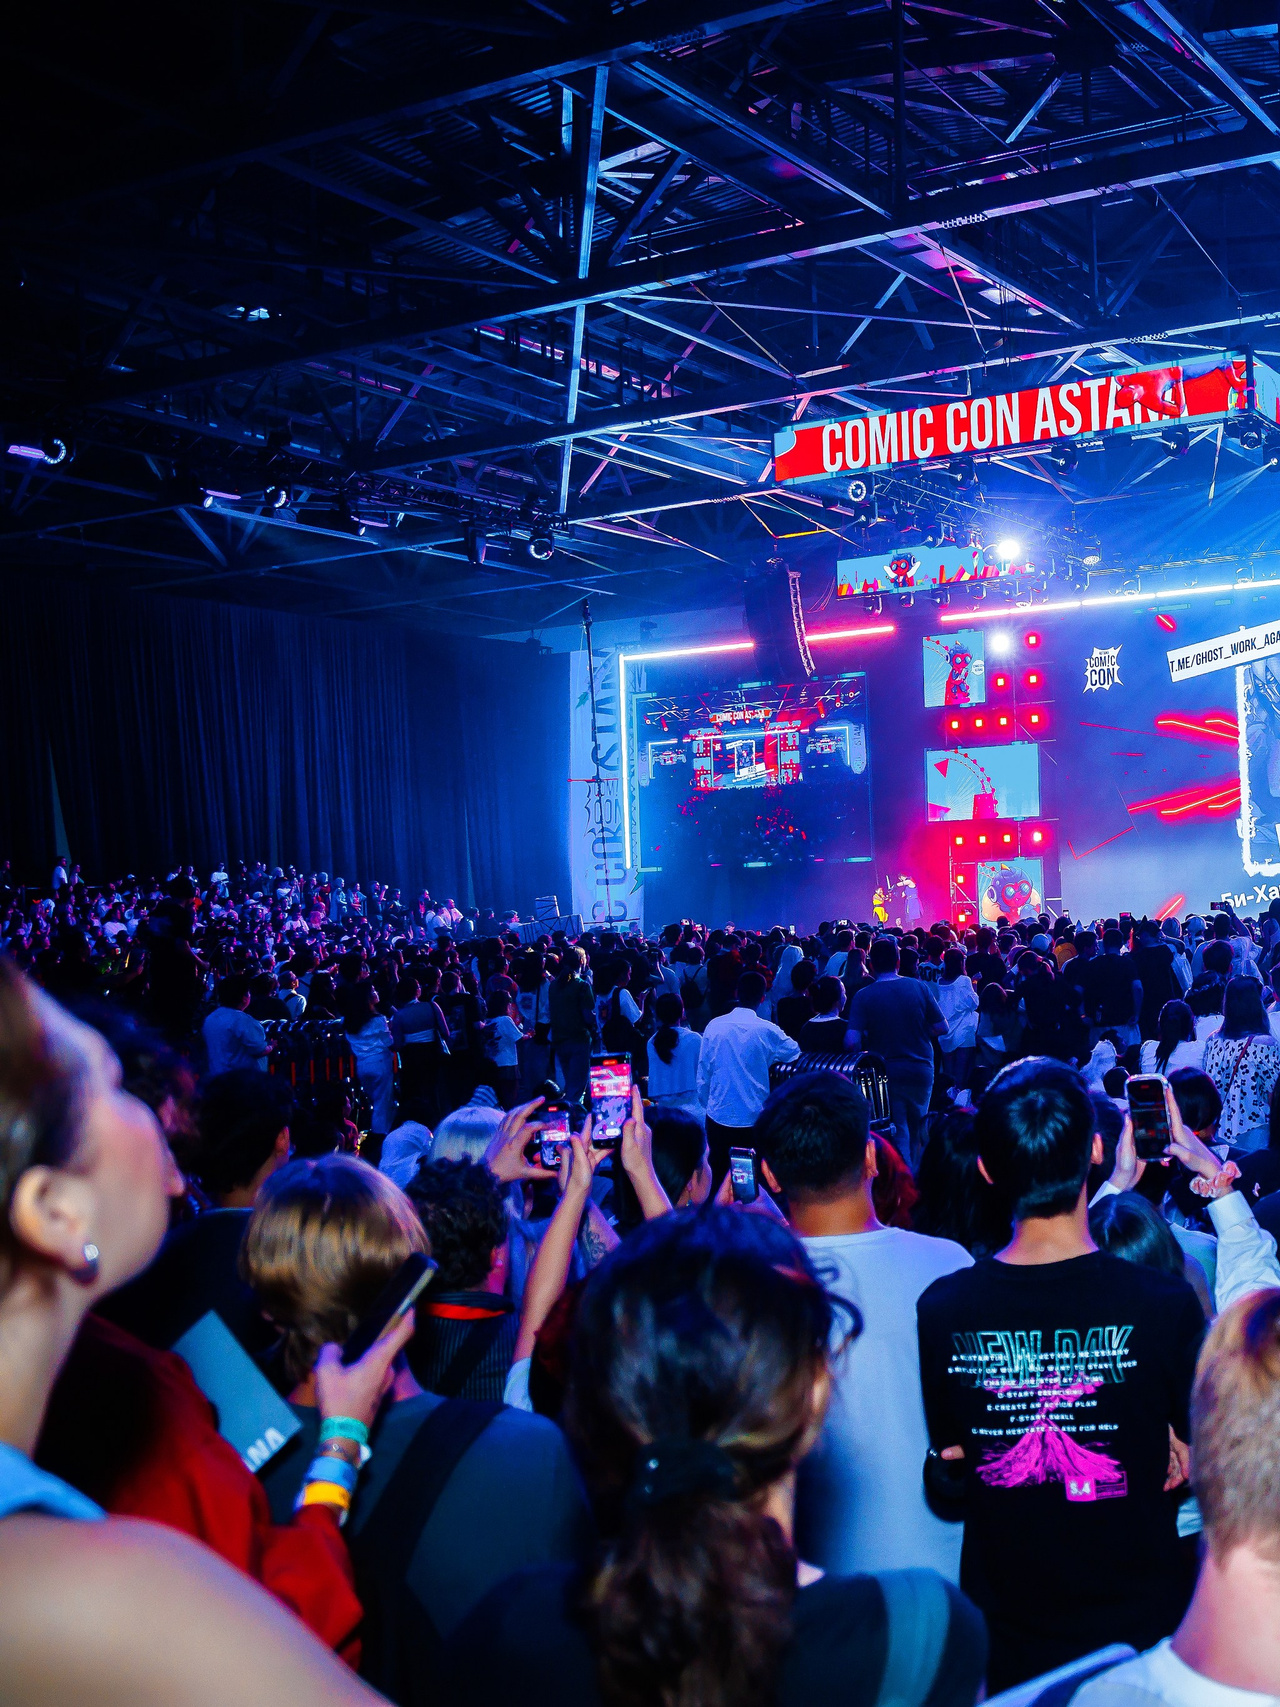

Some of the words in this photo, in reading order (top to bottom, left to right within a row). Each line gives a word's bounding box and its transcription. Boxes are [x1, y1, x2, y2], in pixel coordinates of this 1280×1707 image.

[822, 407, 935, 472] COMIC
[946, 391, 1021, 453] CON
[1089, 668, 1115, 686] CON
[952, 1330, 1042, 1388] NEW
[1055, 1325, 1134, 1387] DAY
[1075, 1400, 1097, 1408] PLAN
[1049, 1413, 1075, 1421] SMALL
[1098, 1423, 1119, 1431] HELP
